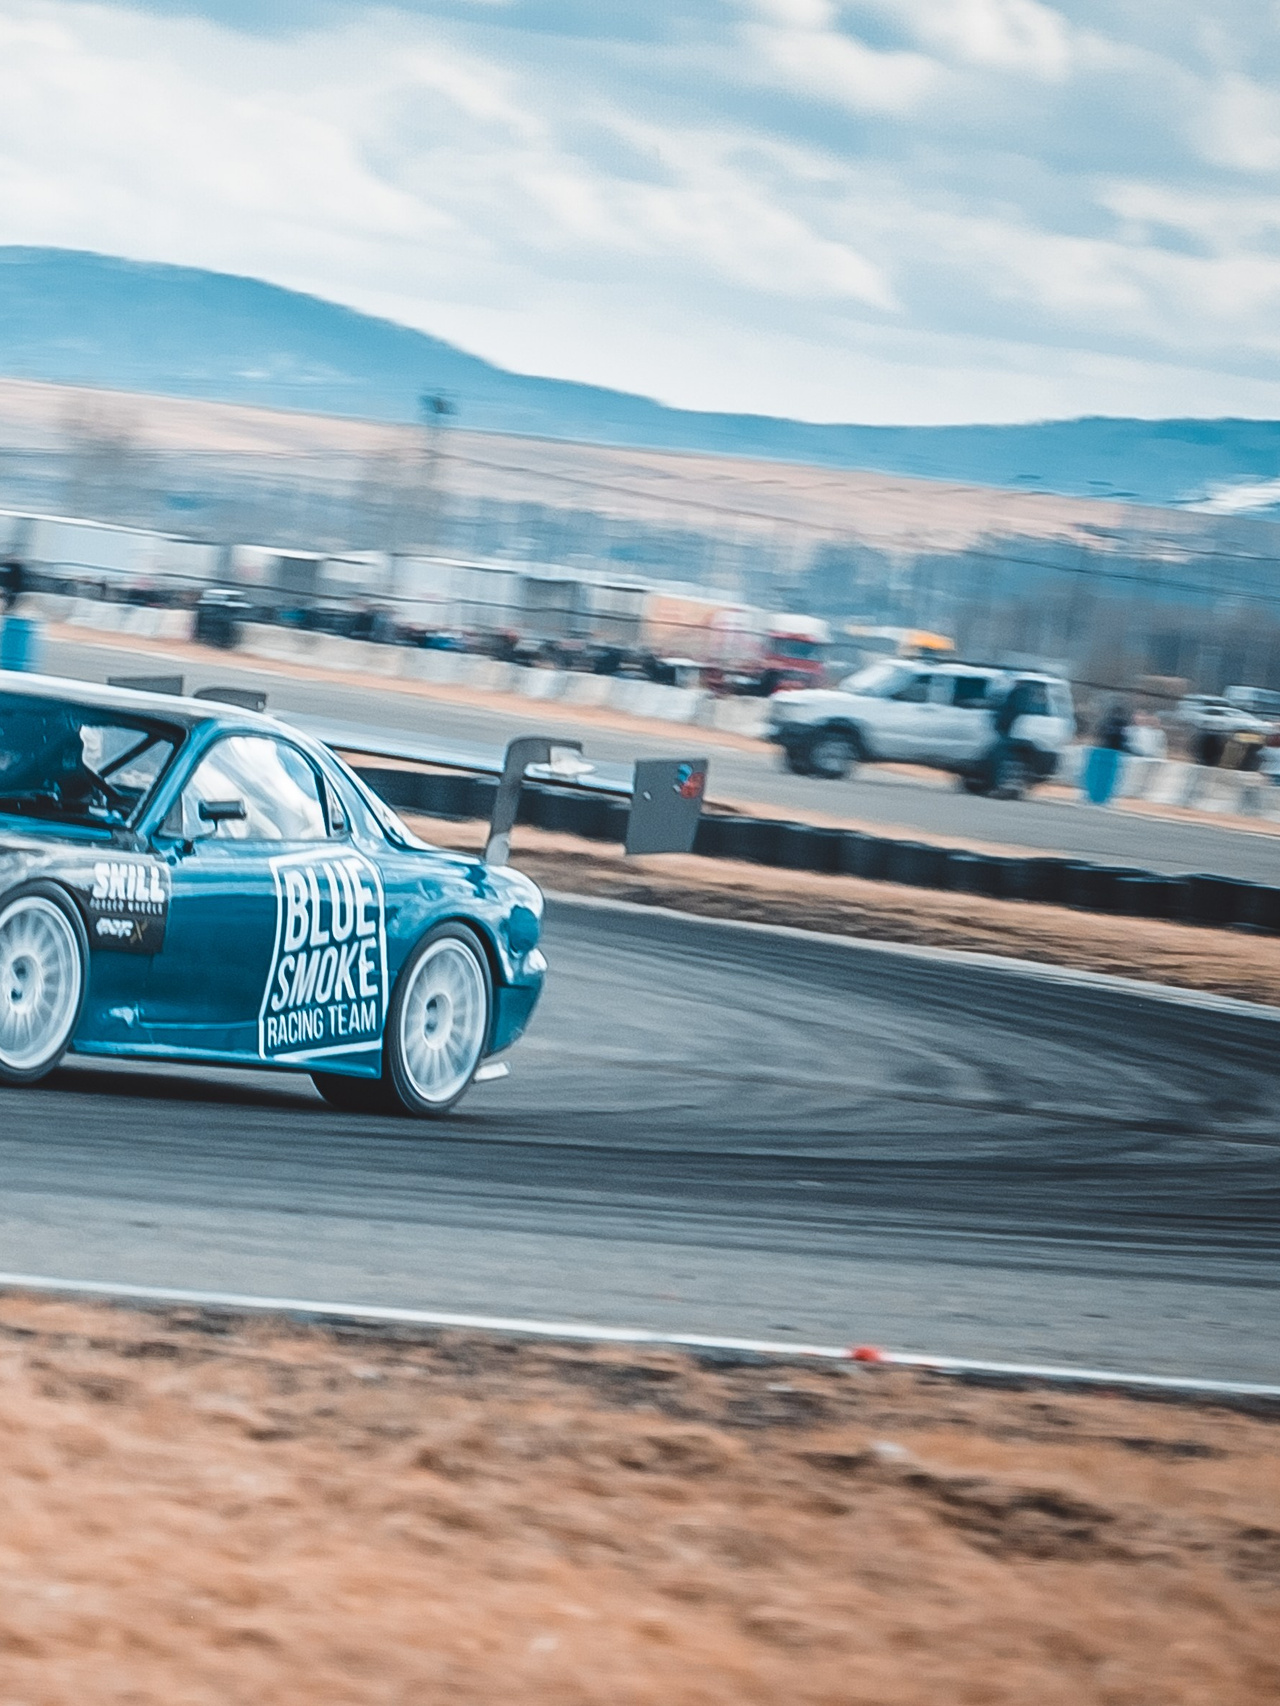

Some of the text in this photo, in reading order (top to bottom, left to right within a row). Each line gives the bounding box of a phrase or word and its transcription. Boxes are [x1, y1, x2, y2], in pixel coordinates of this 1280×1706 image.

[92, 862, 165, 903] SKILL
[283, 857, 376, 953] BLUE
[270, 937, 379, 1012] SMOKE
[266, 1000, 377, 1048] RACING TEAM
